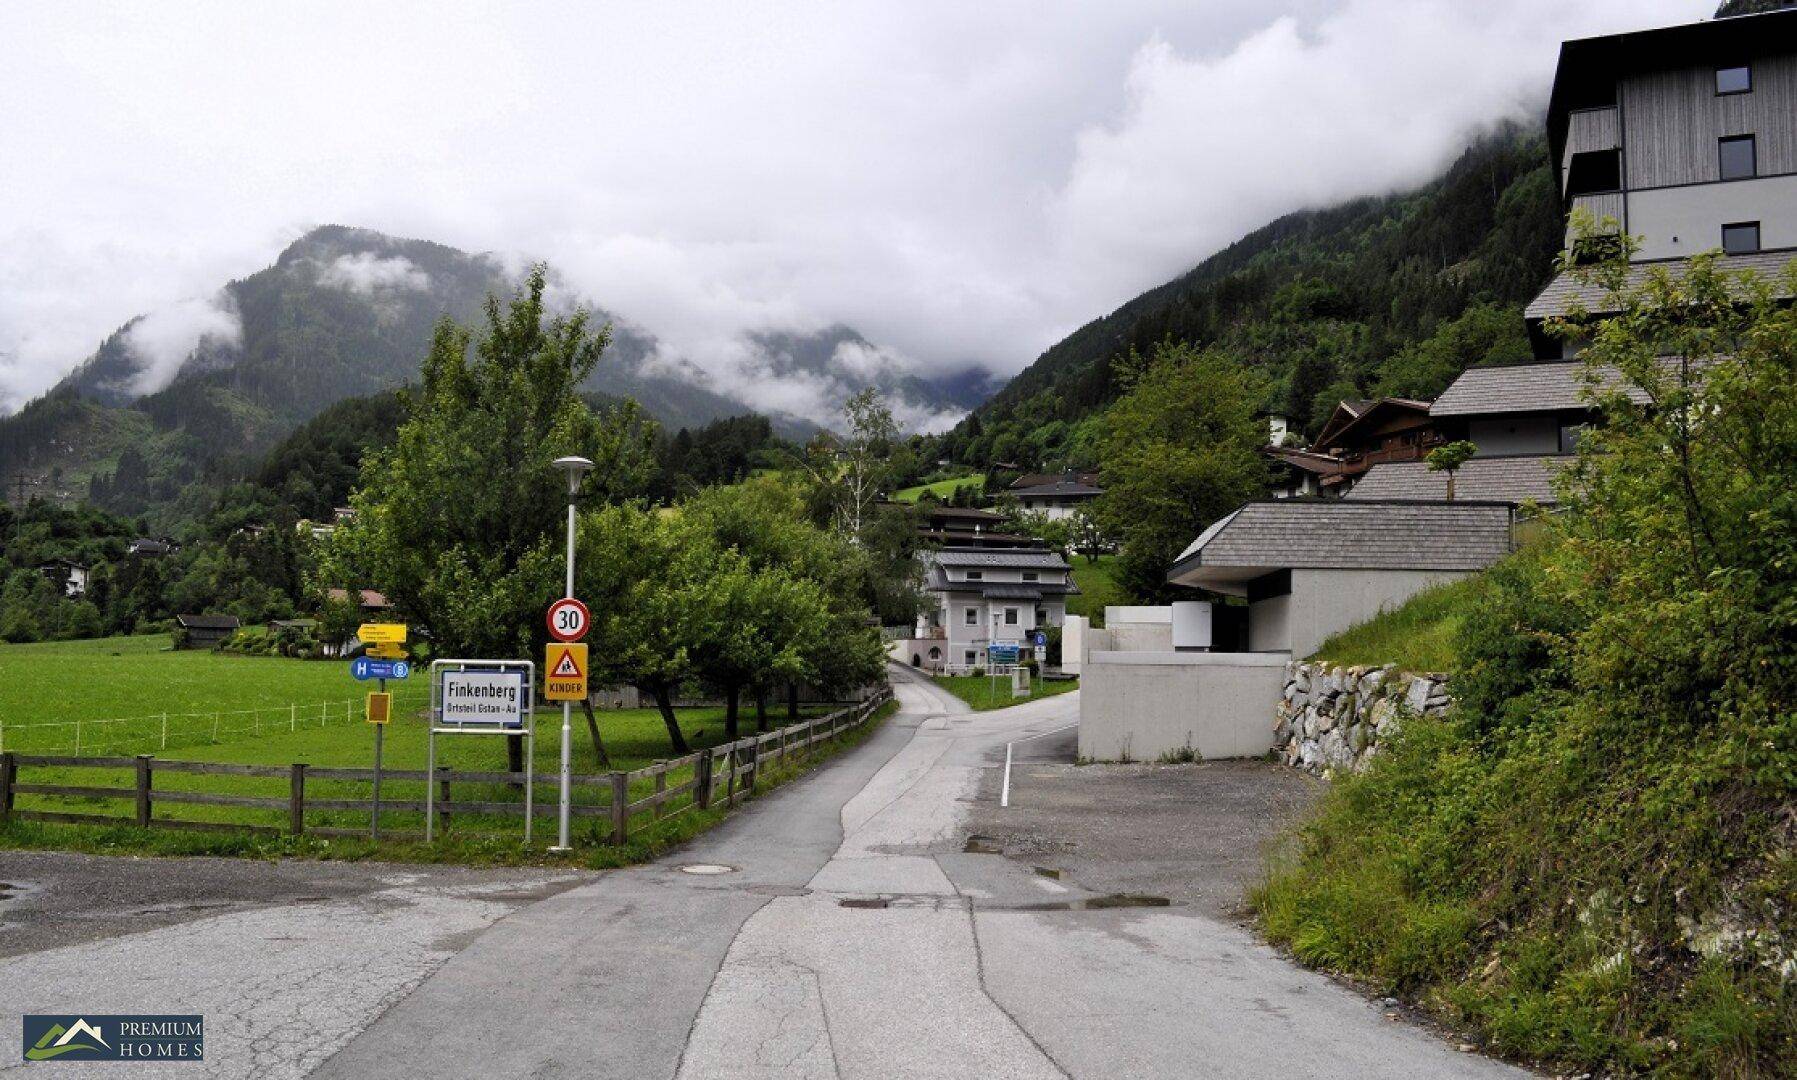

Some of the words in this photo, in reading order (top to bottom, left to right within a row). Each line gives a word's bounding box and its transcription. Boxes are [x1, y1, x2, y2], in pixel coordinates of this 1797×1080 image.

[558, 610, 580, 630] 30
[357, 662, 367, 675] H
[449, 682, 516, 702] Finkenberg
[549, 683, 583, 694] KINDER
[447, 702, 476, 714] Ortsteil
